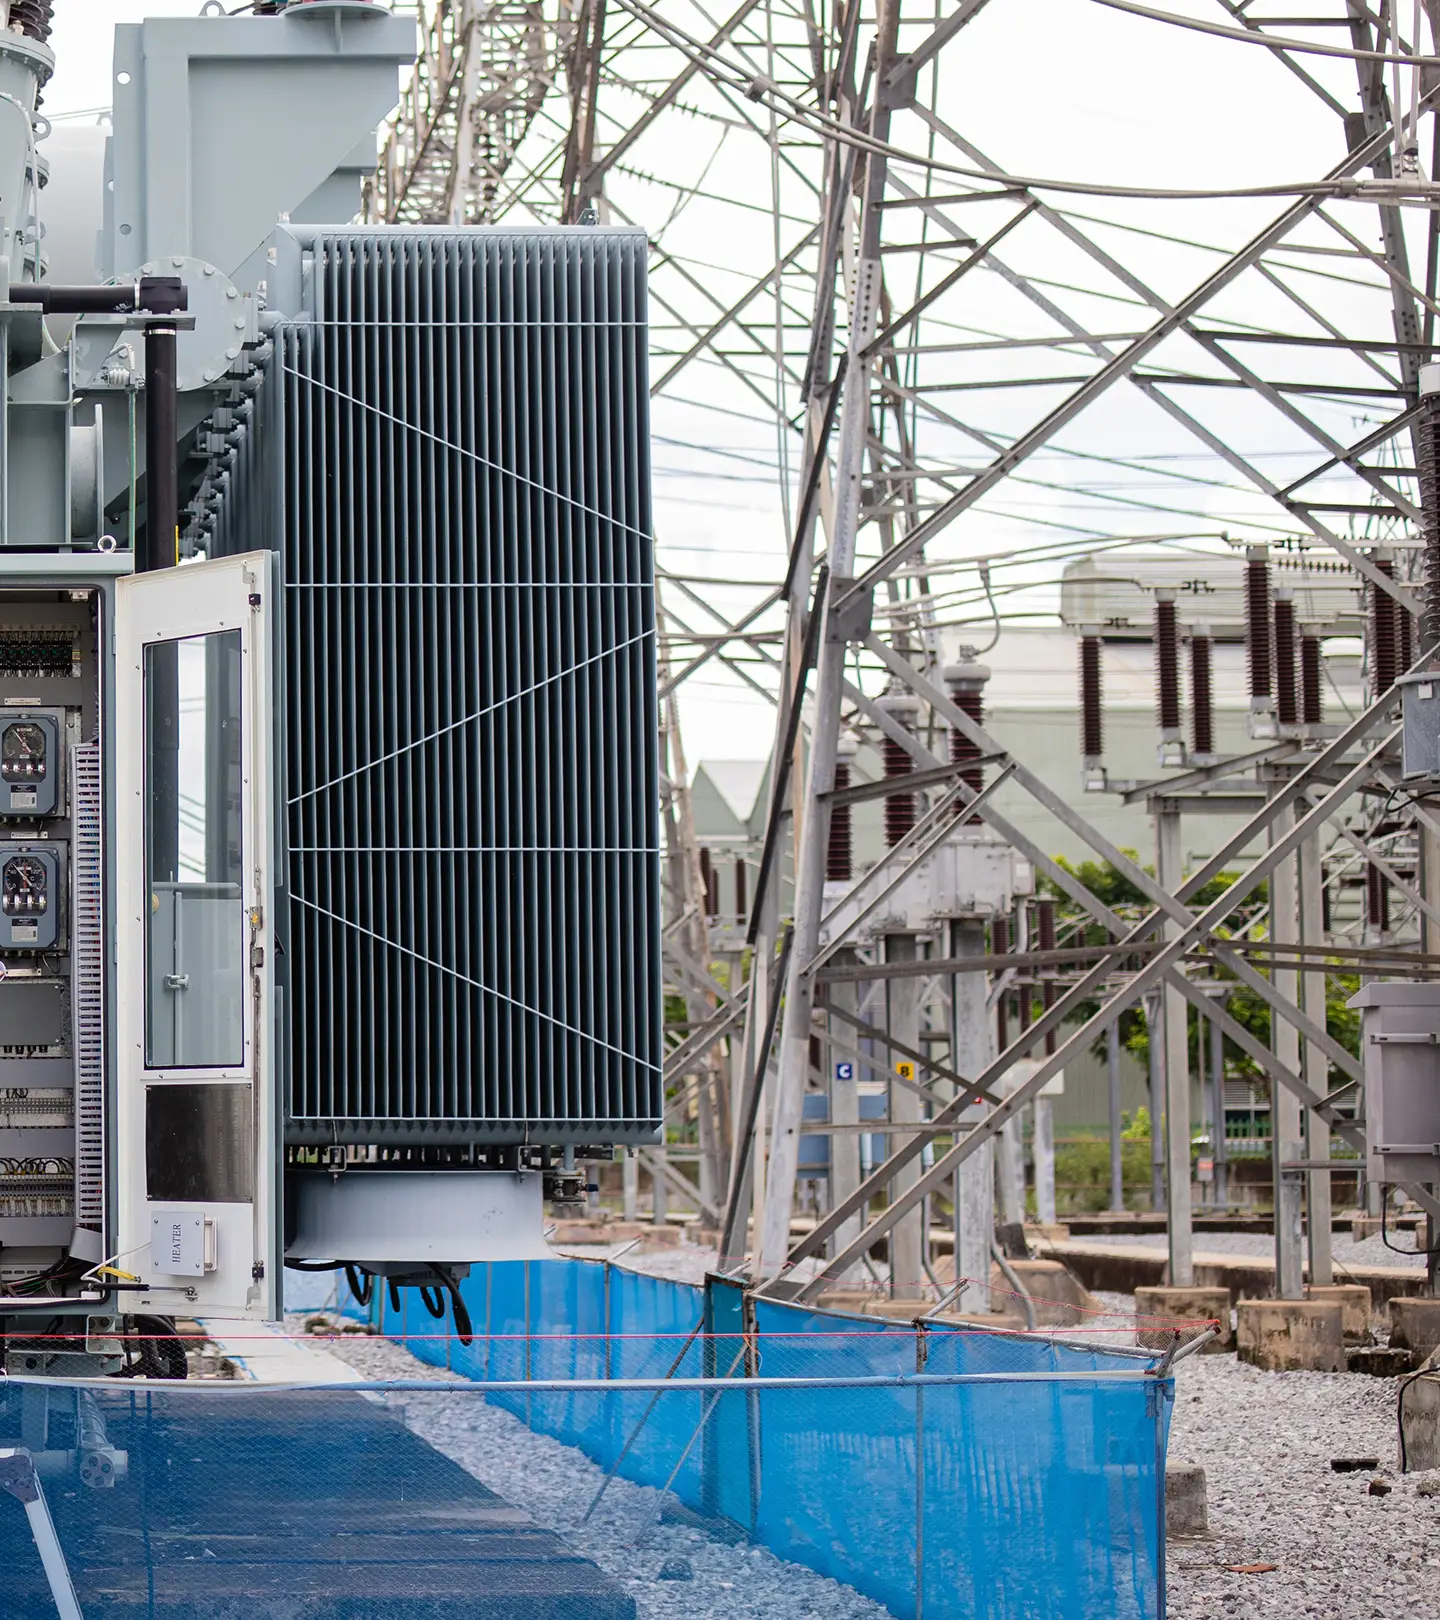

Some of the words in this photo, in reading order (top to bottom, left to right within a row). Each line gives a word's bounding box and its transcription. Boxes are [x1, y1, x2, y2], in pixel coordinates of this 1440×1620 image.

[839, 1065, 850, 1078] C
[901, 1066, 909, 1077] B
[172, 1224, 181, 1263] HEATER
